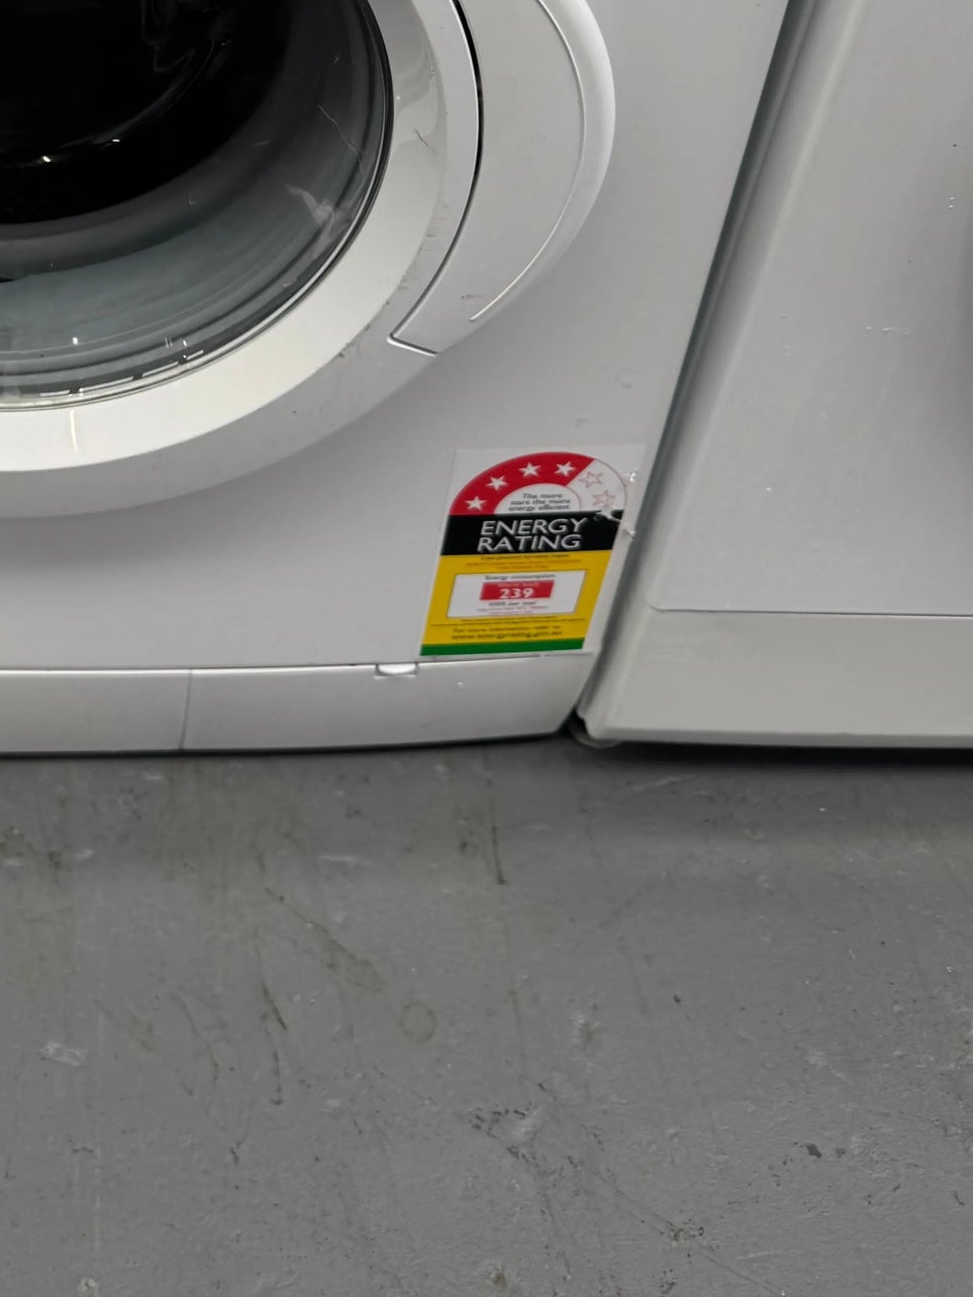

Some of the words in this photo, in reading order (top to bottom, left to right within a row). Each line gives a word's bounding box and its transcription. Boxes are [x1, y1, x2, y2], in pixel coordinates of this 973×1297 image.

[480, 518, 587, 536] ENERGY
[477, 534, 582, 551] RATING
[499, 588, 535, 599] 239
